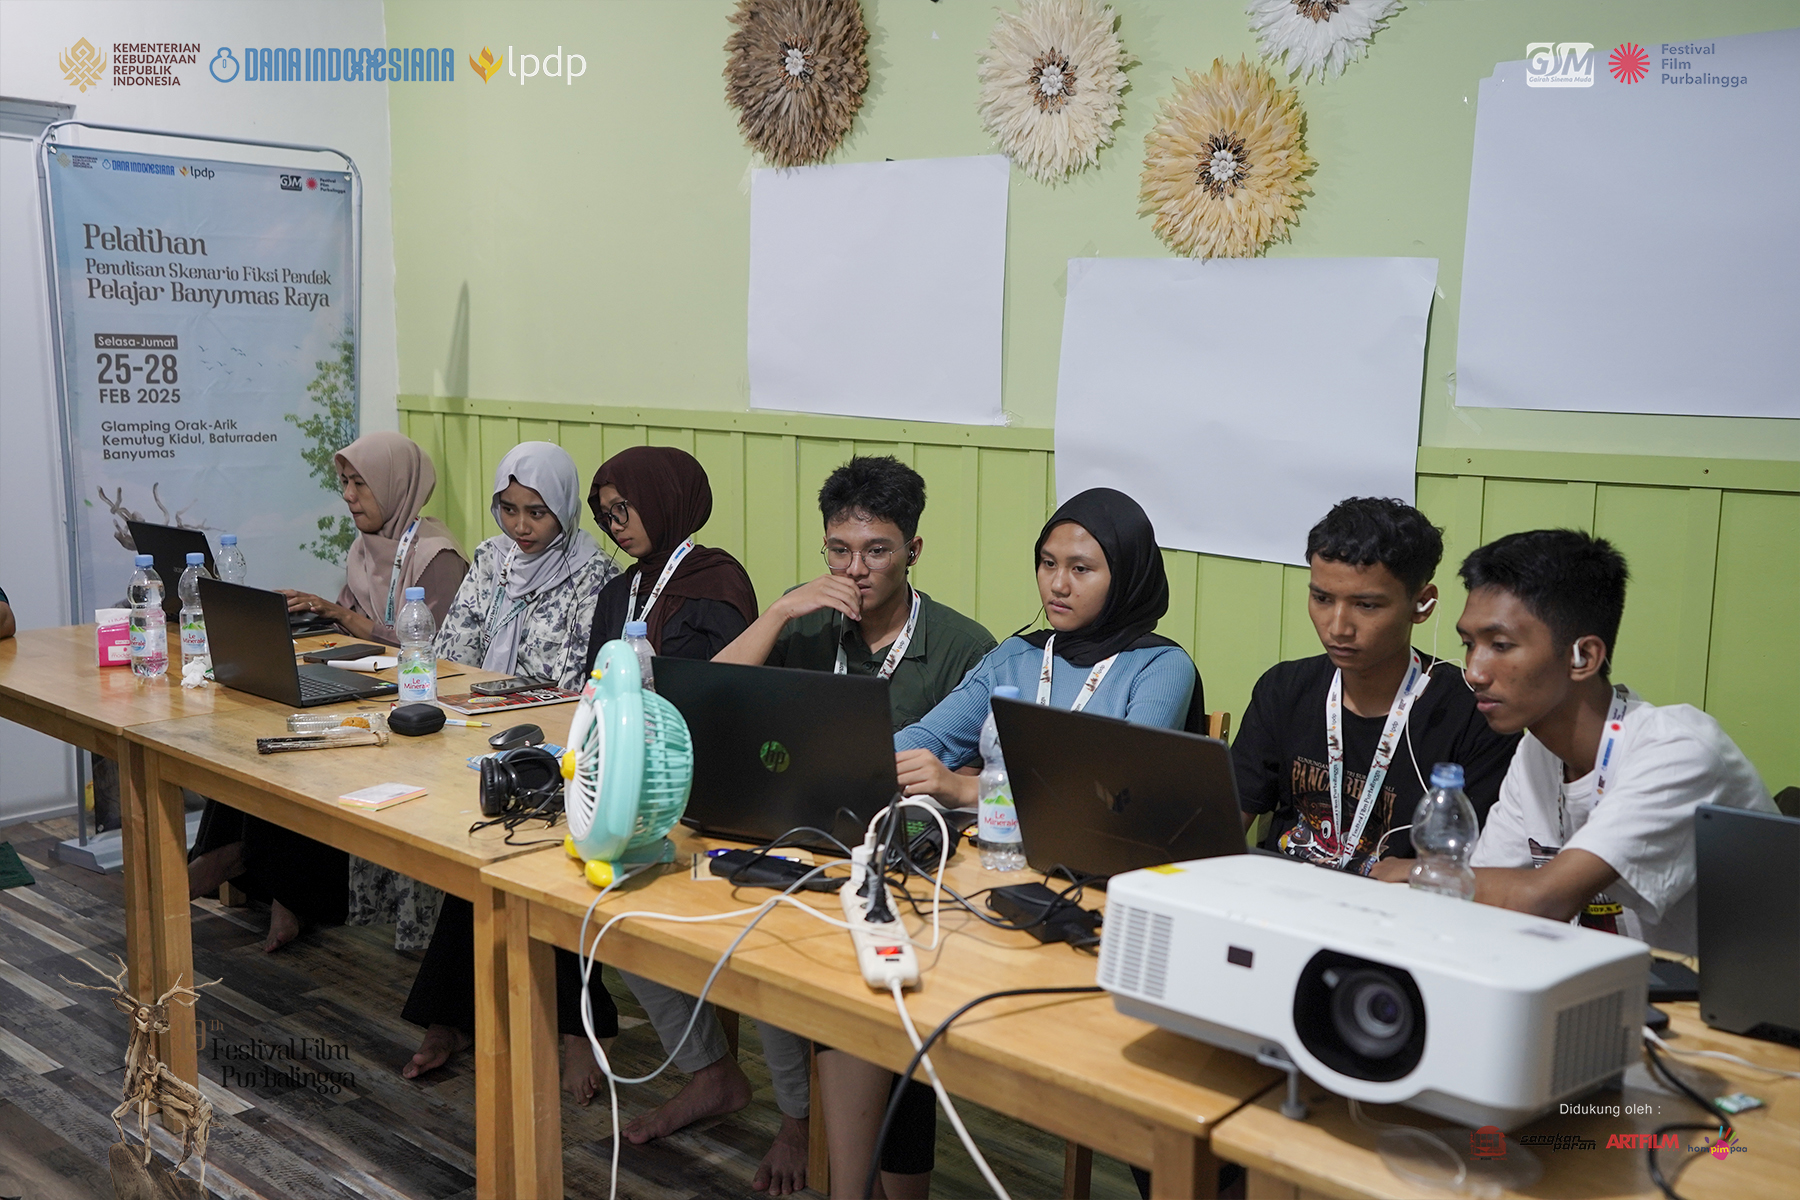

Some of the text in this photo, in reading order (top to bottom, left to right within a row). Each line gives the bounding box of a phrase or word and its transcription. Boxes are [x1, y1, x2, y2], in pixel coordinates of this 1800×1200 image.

[190, 166, 215, 180] lpdp
[83, 223, 208, 256] Pelatihan
[86, 258, 332, 286] Penulisan Skenario Fiksi Pendek
[87, 278, 330, 312] Pelajar Banyumas Raya
[98, 336, 176, 348] Selasa-Jumat
[97, 353, 178, 385] 25-28
[100, 388, 181, 404] FEB 2025
[101, 418, 238, 434] Glamping Orak-Arik
[102, 432, 278, 448] Kemutug Kidul, Baturraden
[103, 448, 176, 462] Banyumas
[984, 816, 1018, 828] Minerale
[994, 810, 1005, 820] Le
